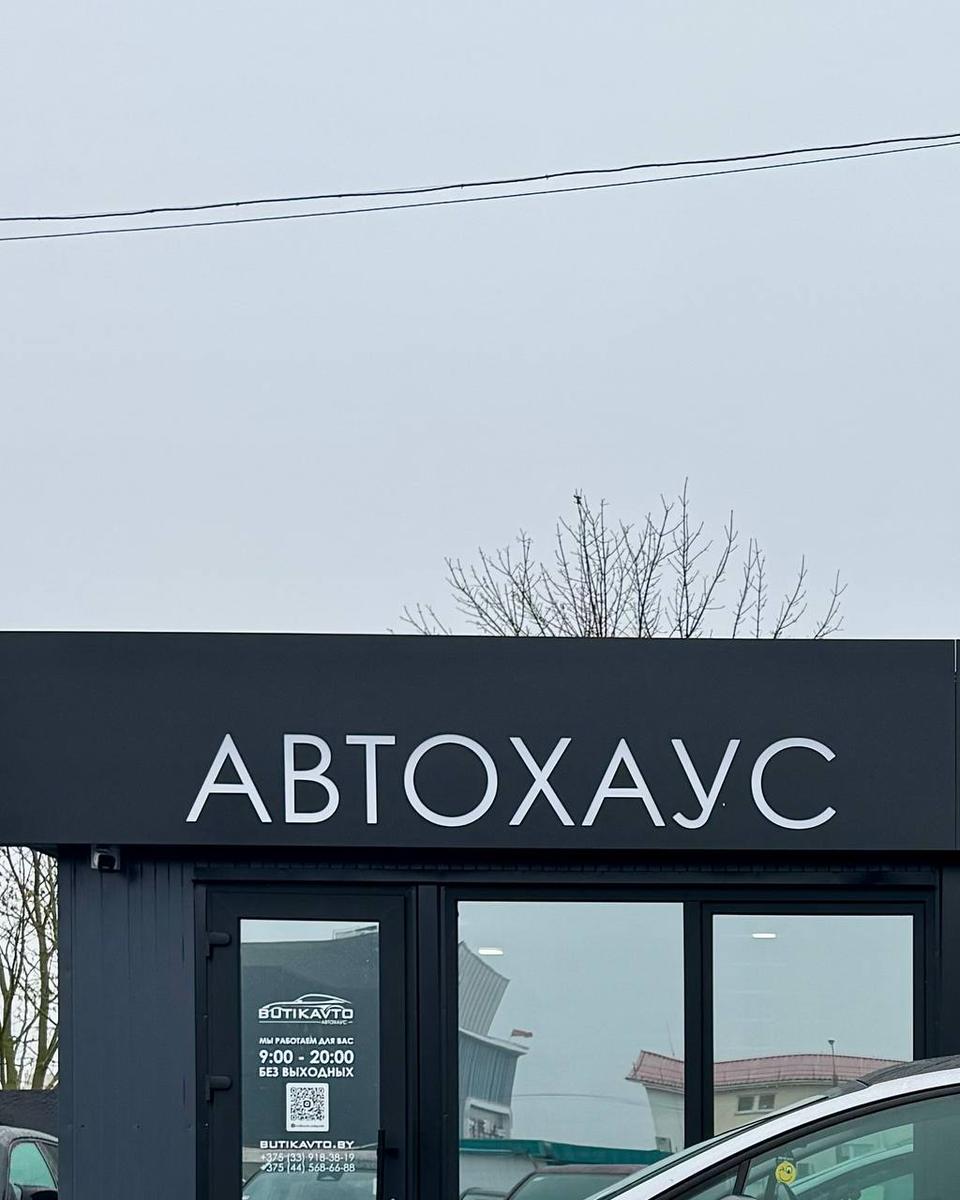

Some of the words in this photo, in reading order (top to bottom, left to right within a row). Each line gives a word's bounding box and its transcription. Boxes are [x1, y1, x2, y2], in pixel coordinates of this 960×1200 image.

[185, 733, 837, 830] АВТОХАУС
[258, 1008, 354, 1020] BUTIKAVTO
[259, 1037, 274, 1045] МЫ
[275, 1037, 318, 1045] РАБОТАЕМ
[318, 1037, 336, 1046] ДЛЯ
[337, 1037, 355, 1045] ВАС
[259, 1049, 294, 1064] 9:00
[309, 1049, 355, 1064] 20:00
[259, 1066, 279, 1078] БЕЗ
[282, 1066, 354, 1079] ВЫХОДНЫХ
[260, 1140, 355, 1149] BUTIKAVTO.BY
[260, 1152, 285, 1163] +375
[286, 1152, 305, 1164] (33)
[308, 1152, 355, 1163] 918-38-19
[286, 1162, 305, 1174] (44)
[308, 1162, 356, 1173] 568-66-88
